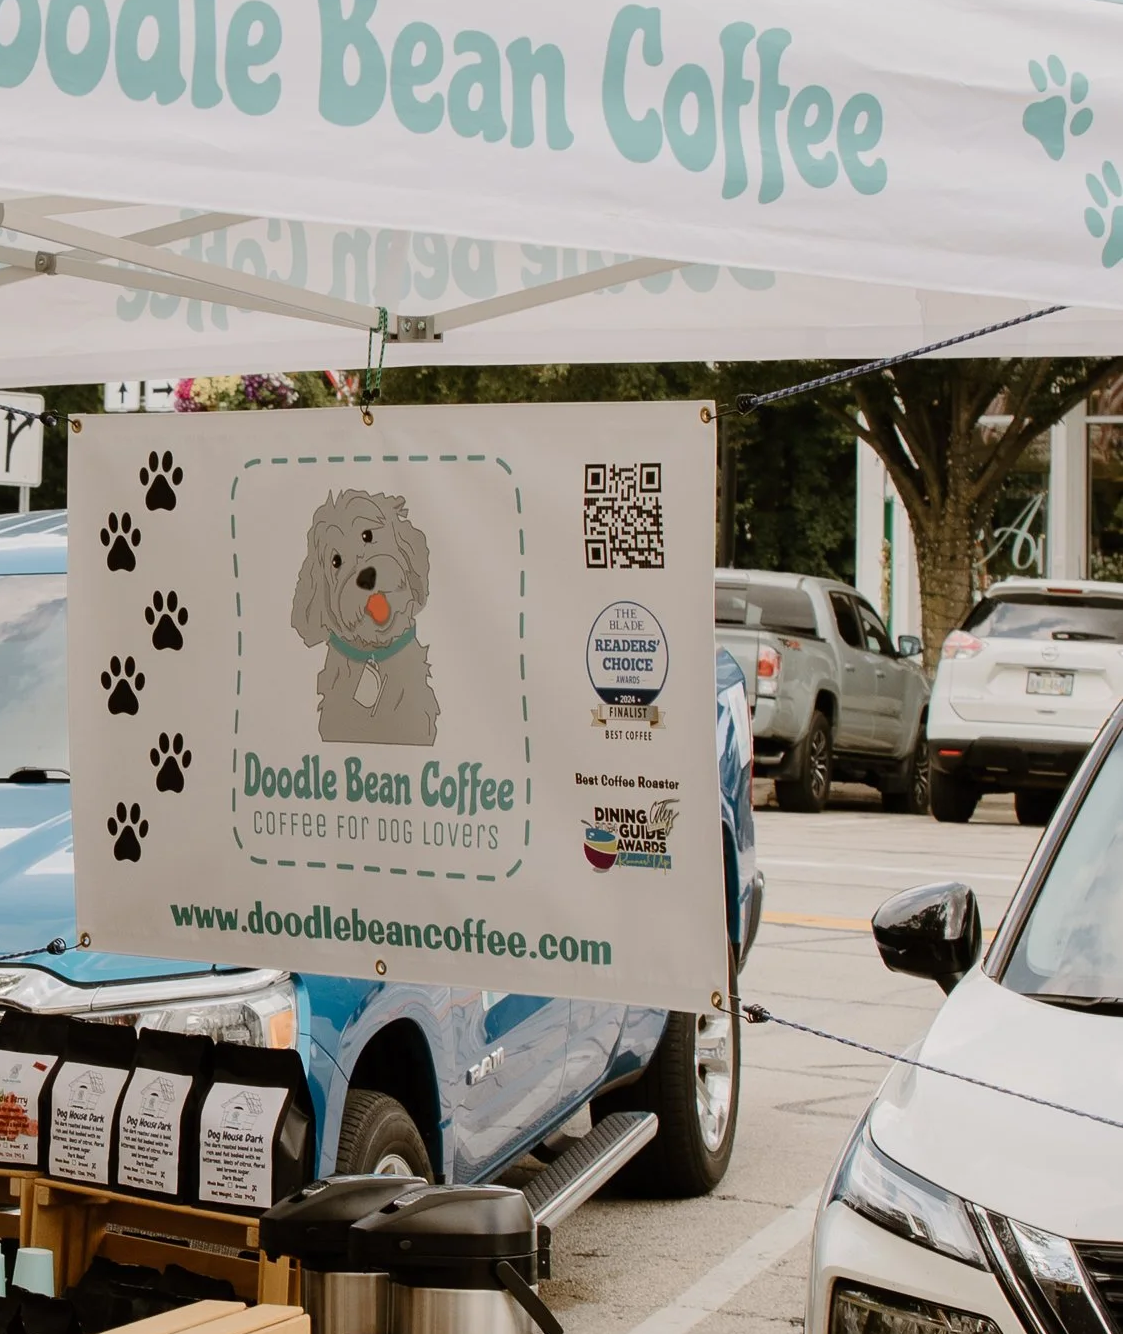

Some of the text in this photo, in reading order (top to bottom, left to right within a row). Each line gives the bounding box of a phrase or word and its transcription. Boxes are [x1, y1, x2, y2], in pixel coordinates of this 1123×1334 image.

[601, 4, 888, 205] Coffee
[614, 608, 638, 619] THE
[609, 620, 645, 631] BLADE
[602, 657, 654, 672] CHOICE
[616, 675, 641, 685] AWARDS
[619, 694, 636, 704] 2024
[609, 706, 648, 719] FINALIST
[604, 729, 652, 741] BEST COFFEE
[244, 751, 514, 817] Doodle Bean Coffee
[575, 772, 680, 790] Best Coffee Roaster
[594, 807, 647, 824] DINING
[378, 817, 412, 845] DOG
[619, 824, 667, 841] GUIDE
[616, 839, 667, 854] AWARDS
[170, 900, 613, 966] www.doodlebeancoffee.com
[10, 1094, 28, 1107] Berry
[56, 1107, 105, 1123] Dog House Dark
[127, 1115, 172, 1132] Dog House Dark
[207, 1129, 264, 1144] Dog House Dark
